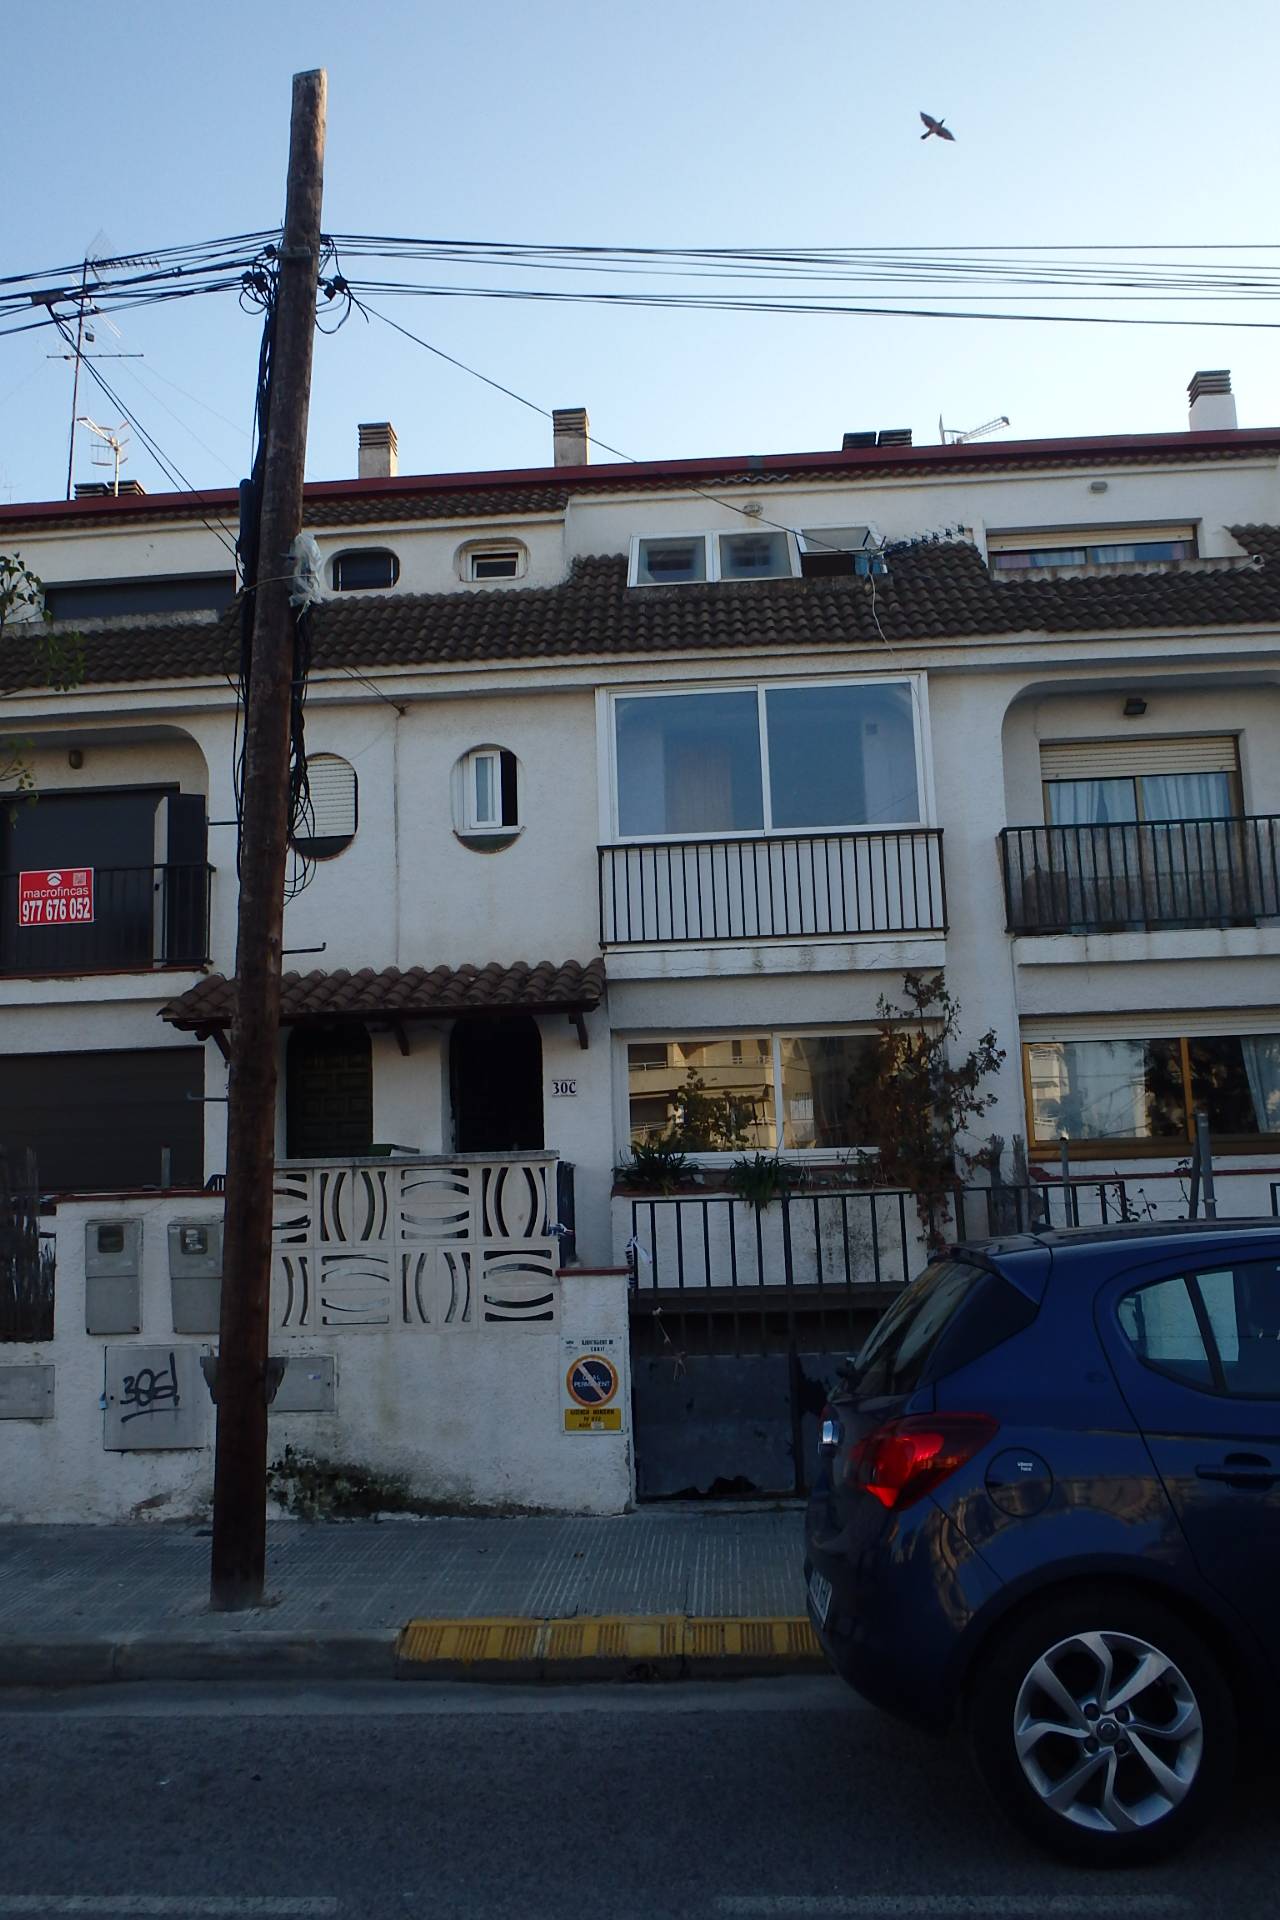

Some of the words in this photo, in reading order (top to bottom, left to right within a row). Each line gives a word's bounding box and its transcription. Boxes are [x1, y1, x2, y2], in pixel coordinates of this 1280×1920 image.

[24, 887, 88, 898] macrofincas
[23, 900, 43, 921] 977
[46, 899, 66, 921] 676
[70, 897, 90, 919] 052
[553, 1082, 576, 1094] 30C
